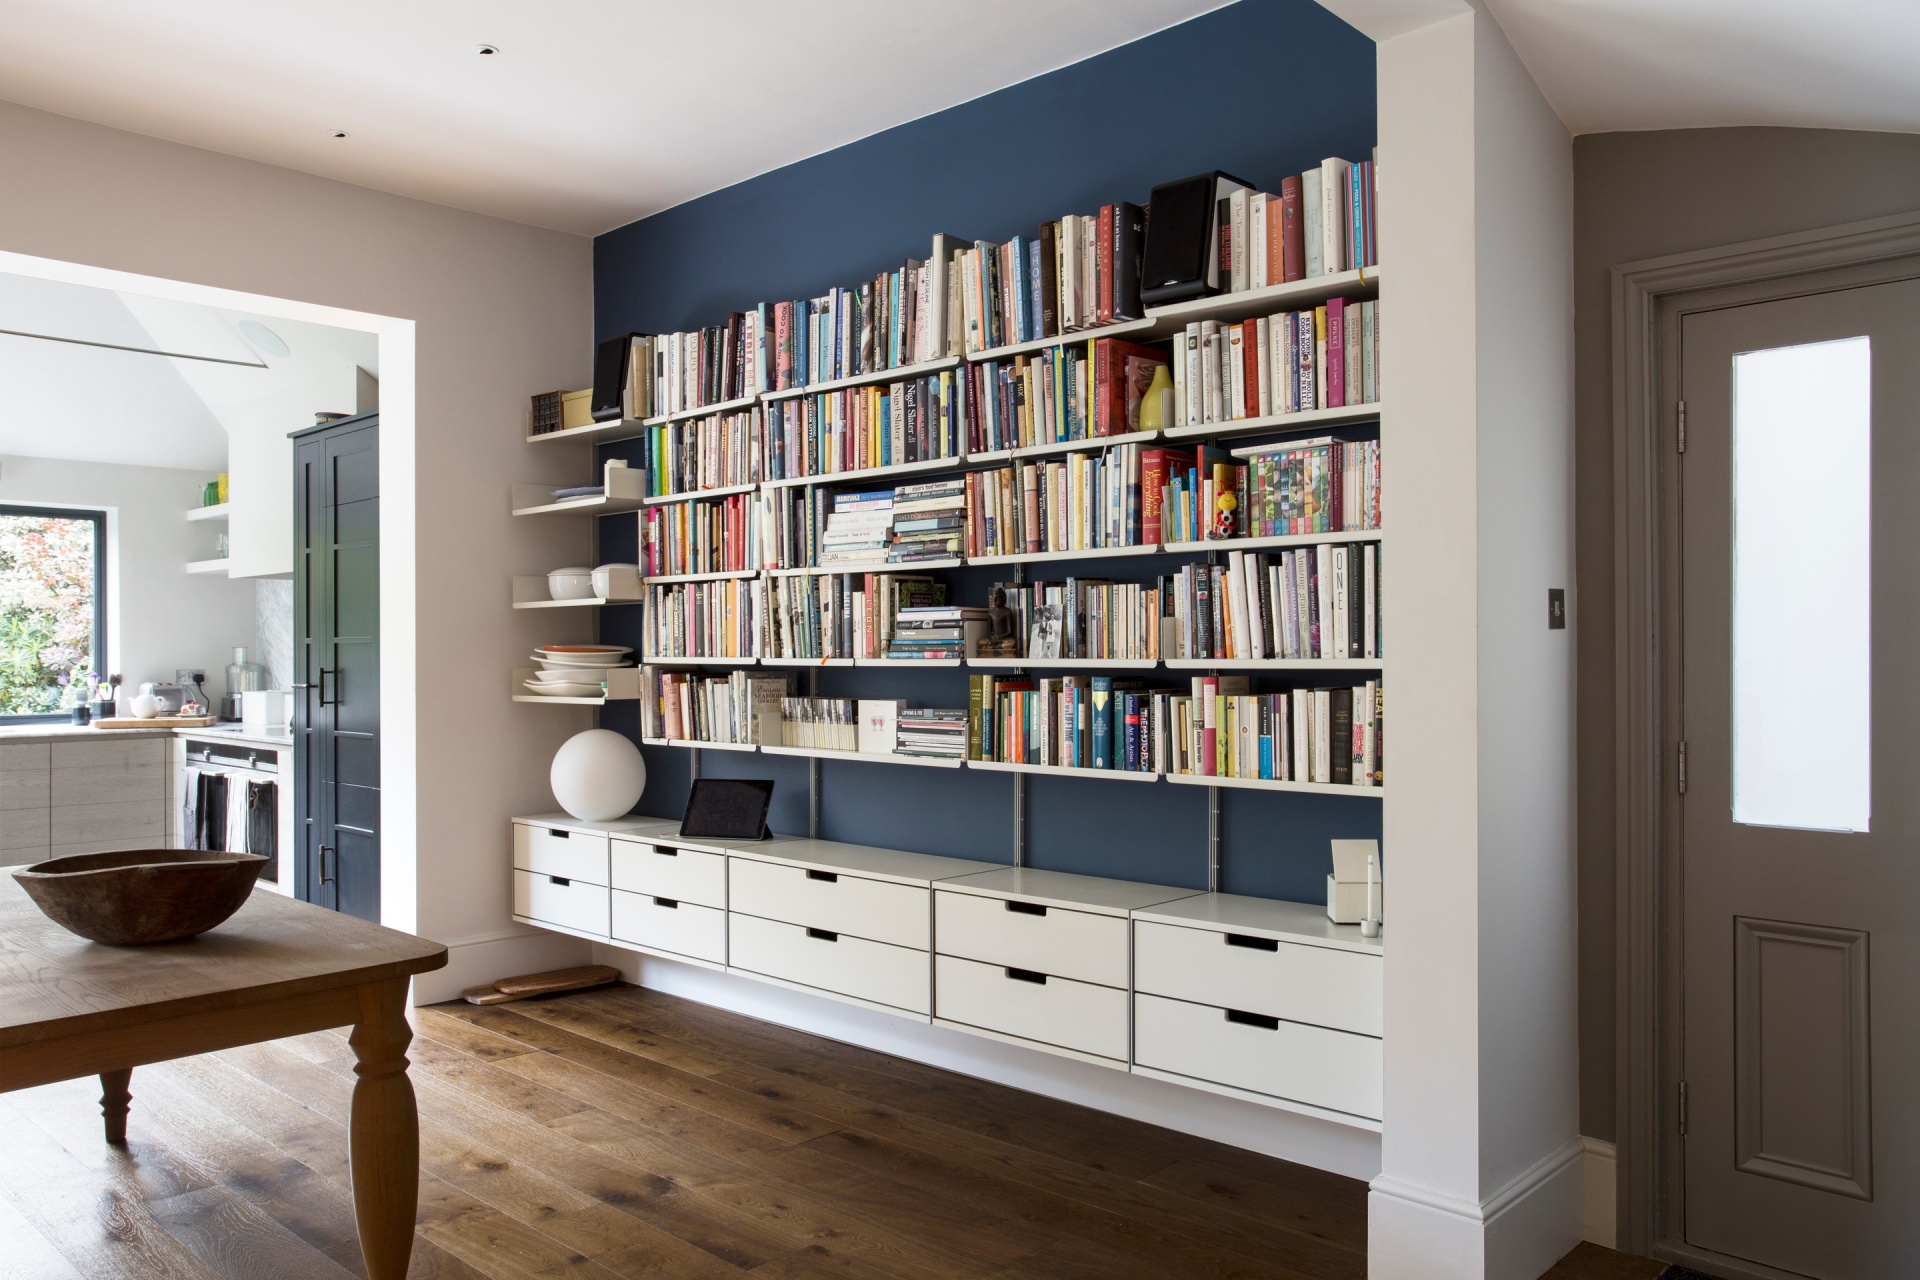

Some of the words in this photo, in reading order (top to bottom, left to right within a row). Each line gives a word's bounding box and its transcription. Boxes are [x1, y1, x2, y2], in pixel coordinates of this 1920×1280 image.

[1235, 201, 1243, 218] The
[1031, 256, 1041, 301] HOME
[690, 335, 698, 374] POLPO
[1306, 371, 1312, 379] by
[893, 387, 902, 411] Nigel
[905, 384, 916, 407] Nigel
[894, 413, 902, 441] Slater
[907, 409, 916, 435] Slater
[1153, 469, 1161, 487] How
[1143, 470, 1154, 518] Everything
[1153, 487, 1160, 495] to
[1153, 495, 1161, 517] Cook
[1297, 554, 1306, 591] Amazing
[1297, 593, 1307, 619] grains
[1065, 688, 1074, 704] RACE
[1065, 713, 1074, 742] LIFETIME
